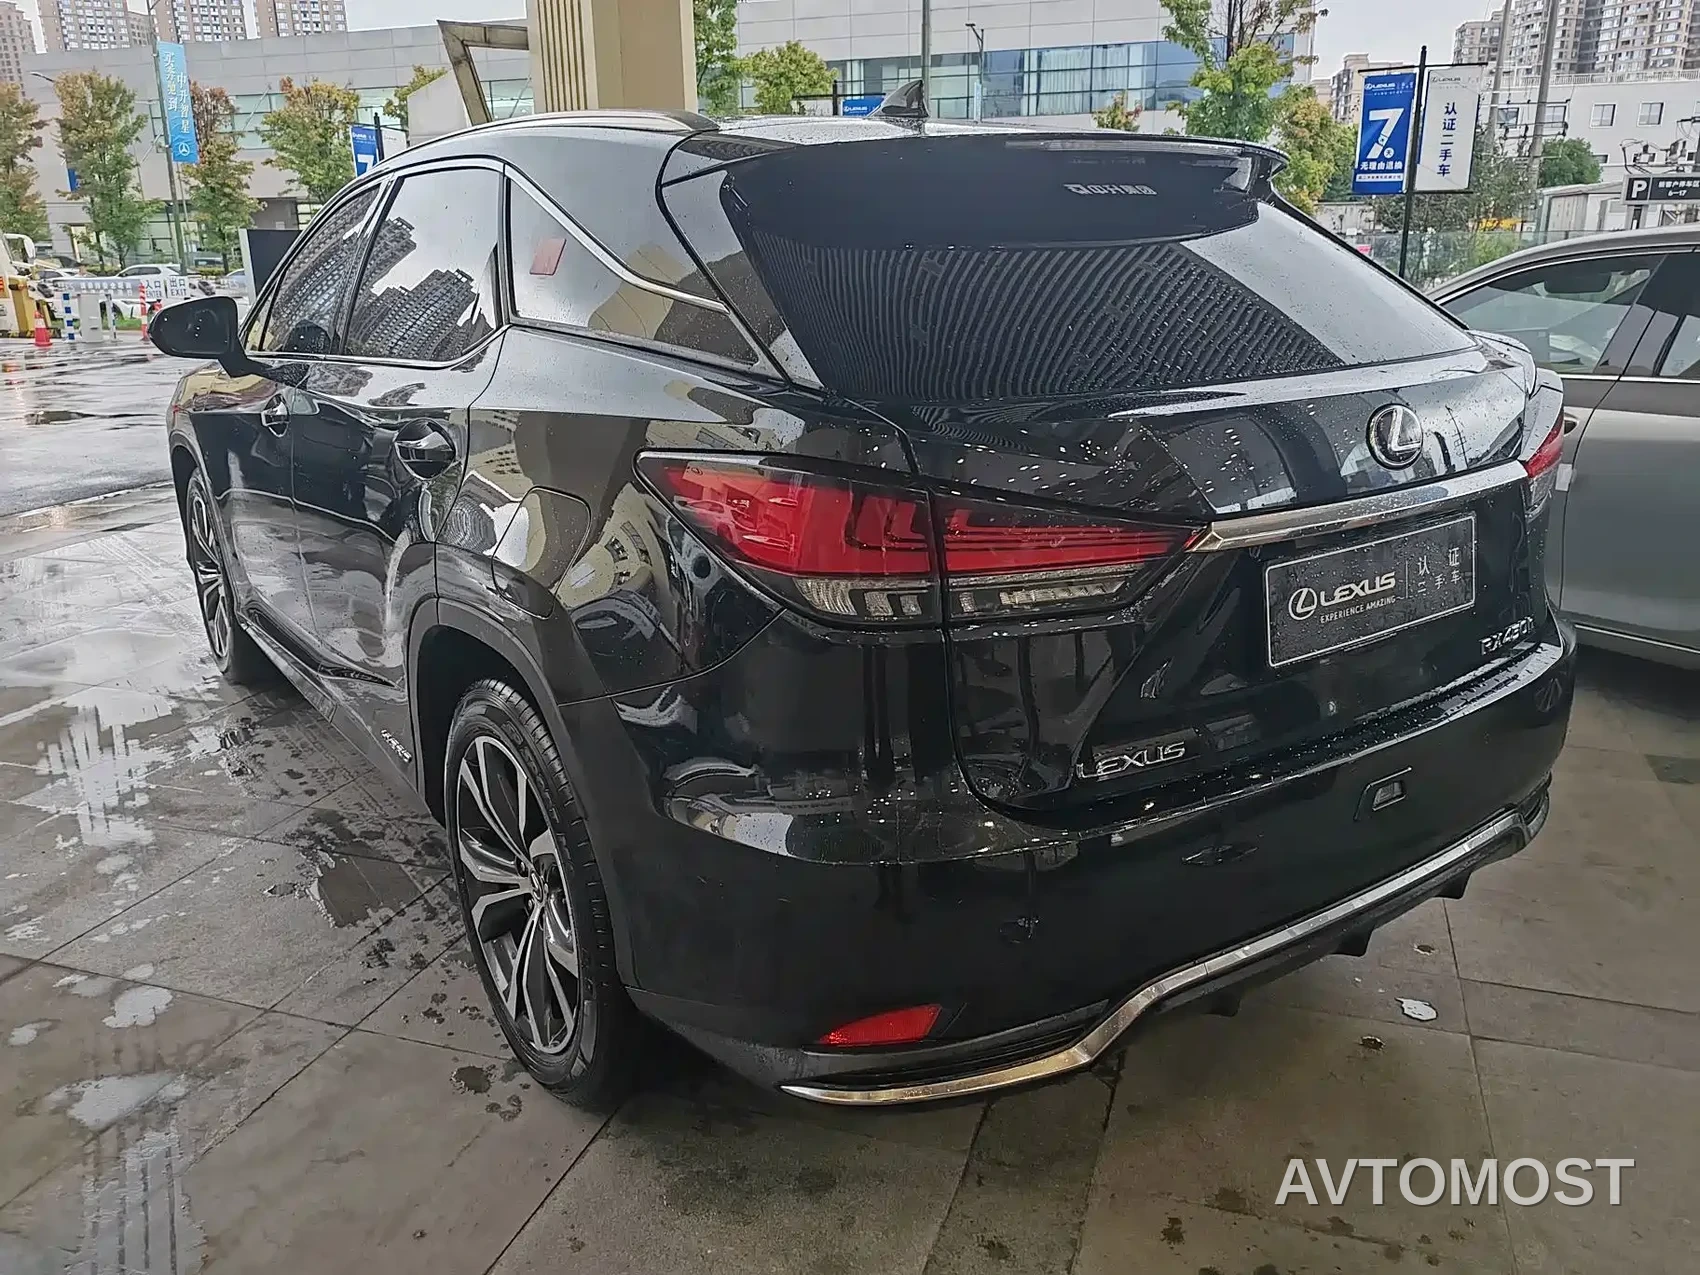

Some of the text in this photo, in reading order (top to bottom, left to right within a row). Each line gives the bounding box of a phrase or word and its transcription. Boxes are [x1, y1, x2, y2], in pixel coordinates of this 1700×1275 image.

[1366, 108, 1405, 159] 7
[1437, 102, 1457, 177] 认证二手车
[1631, 180, 1648, 198] P
[146, 280, 161, 289] 入口
[170, 276, 185, 287] 出口
[171, 289, 187, 297] EXIT
[1320, 571, 1396, 607] LEXUS
[1320, 596, 1396, 624] EXPERIENCE AMAZING
[1076, 741, 1185, 778] LEXUS
